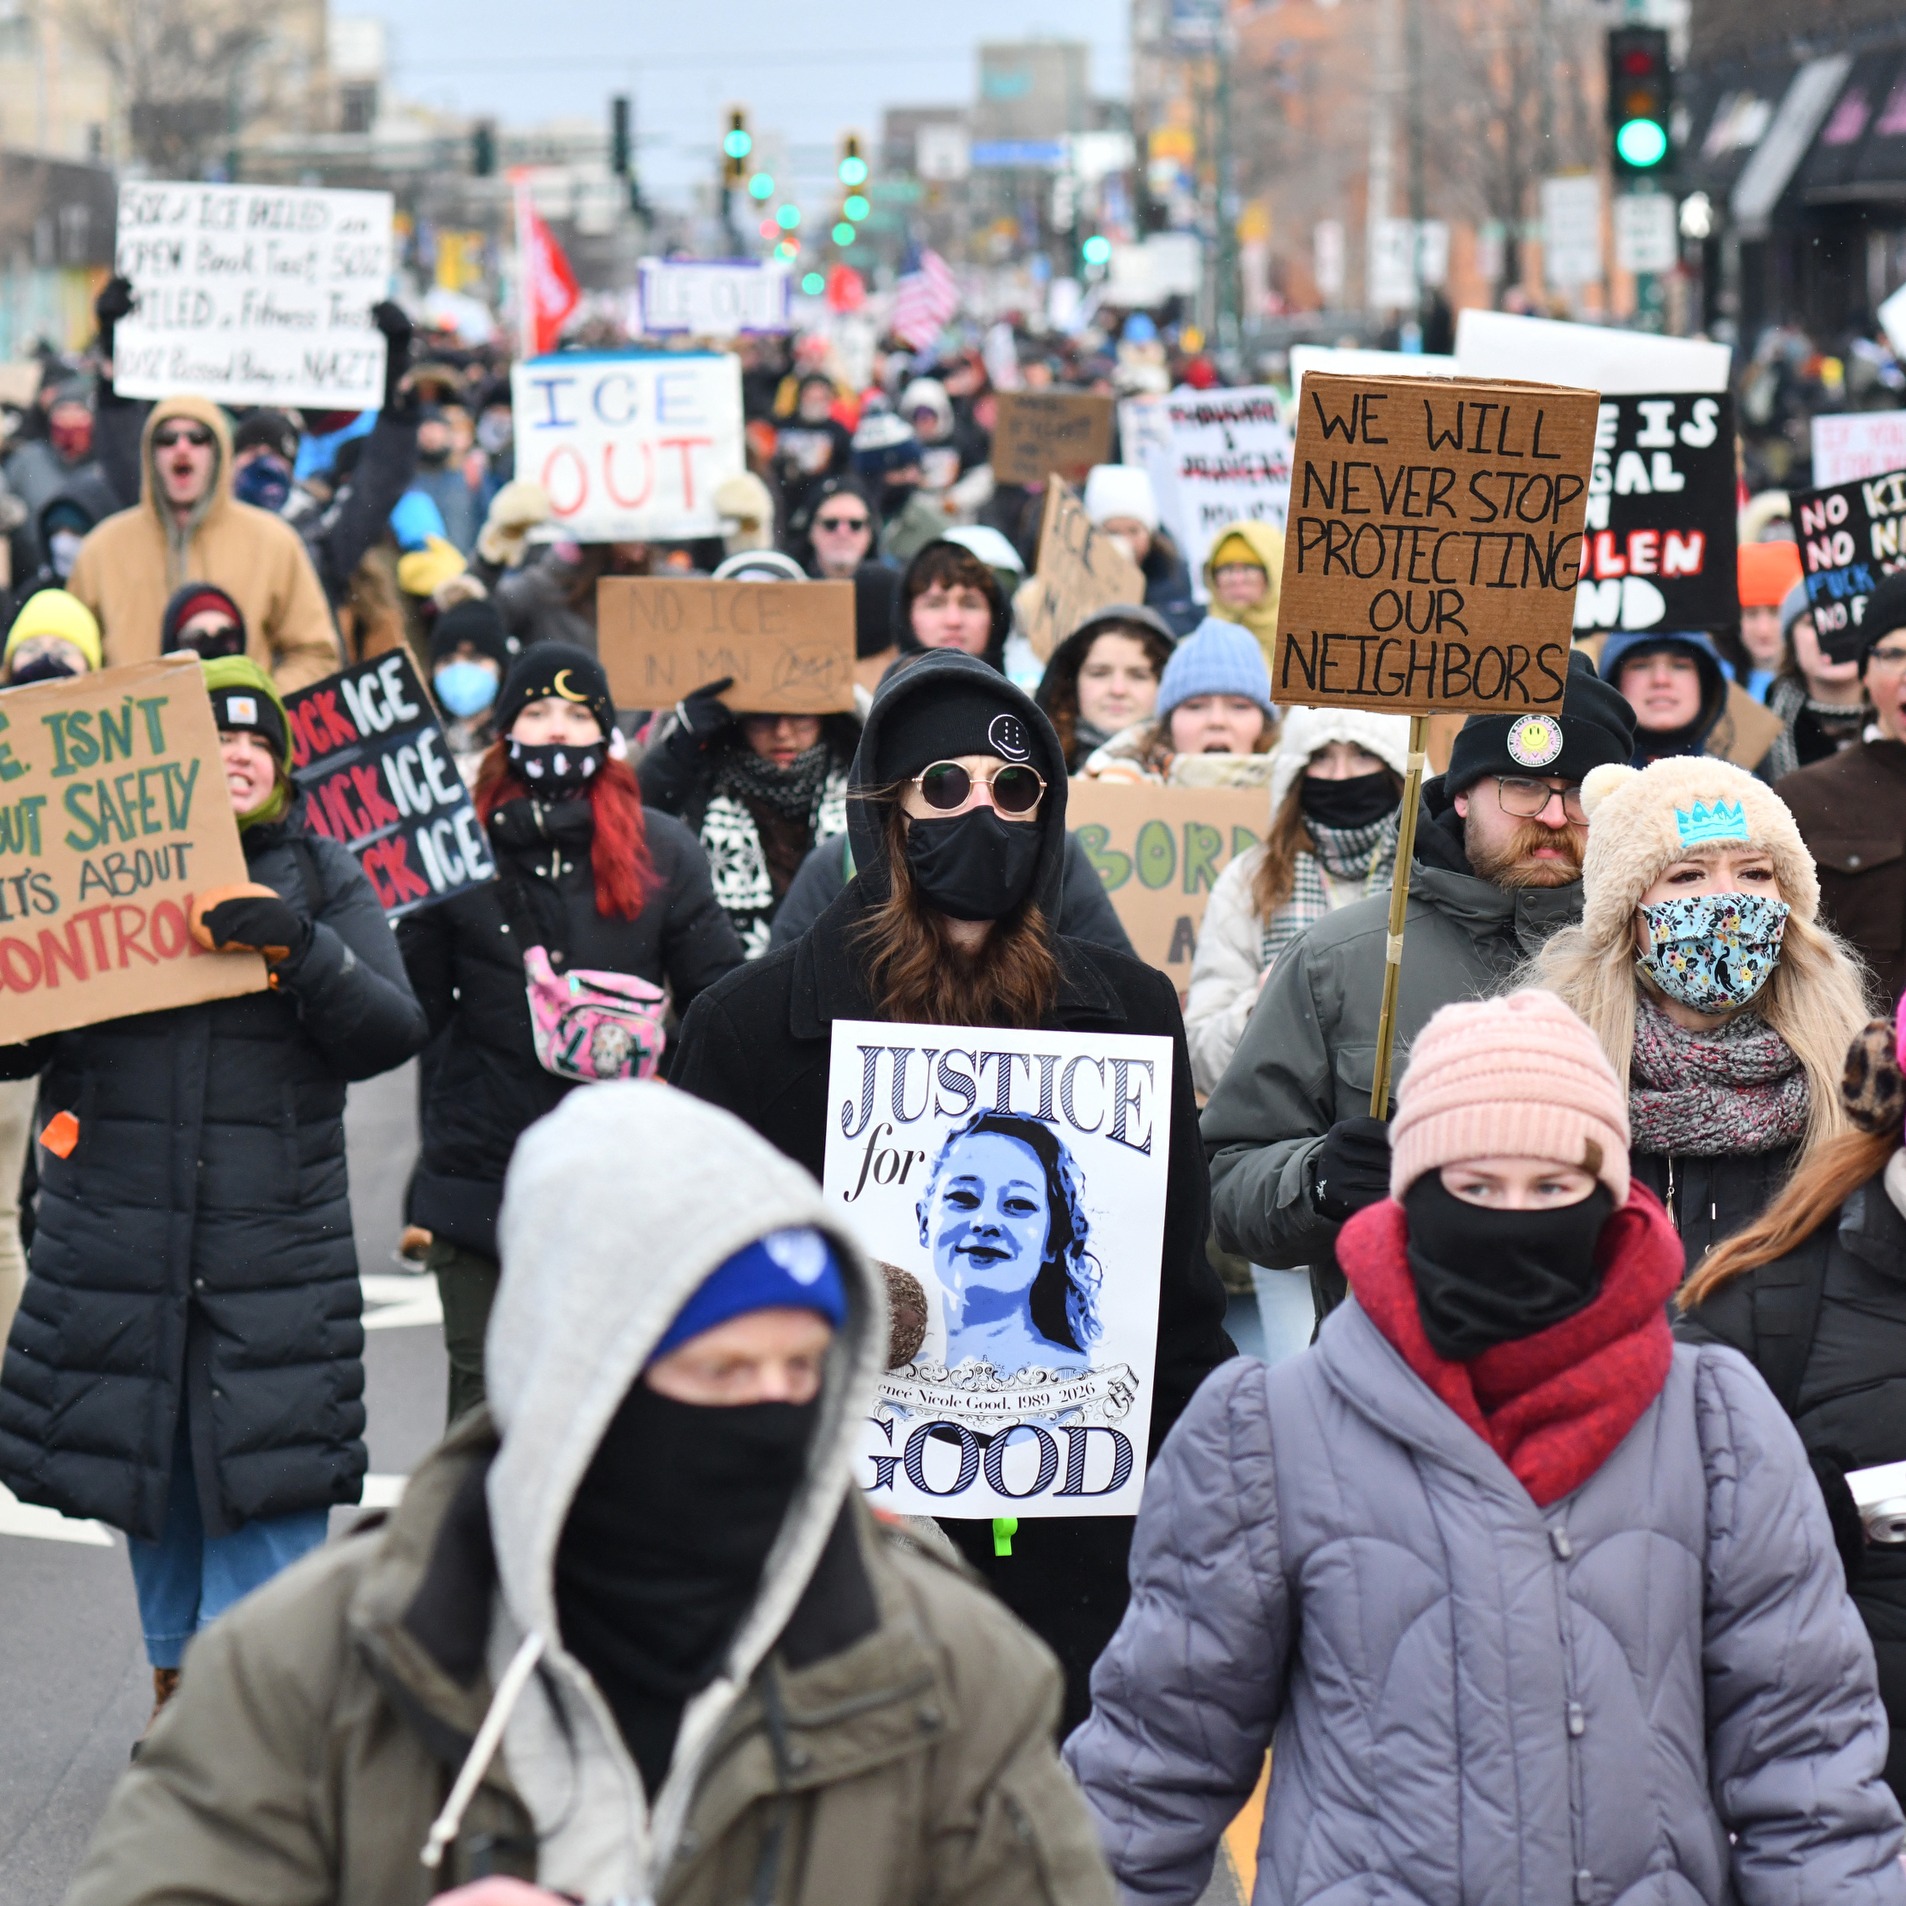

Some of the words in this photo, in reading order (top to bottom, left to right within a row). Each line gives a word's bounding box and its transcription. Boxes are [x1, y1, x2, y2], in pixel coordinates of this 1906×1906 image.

[530, 370, 708, 429] ICE
[1312, 392, 1388, 444] WE
[1423, 399, 1561, 460] WILL
[1636, 398, 1719, 448] IS
[541, 437, 714, 518] OUT
[1302, 460, 1457, 518] NEVER
[1468, 469, 1585, 524] STOP
[1801, 494, 1849, 536] NO
[1806, 530, 1855, 572] NO
[1870, 514, 1906, 559] N
[1297, 516, 1586, 591] PROTECTING
[1806, 562, 1876, 600] FUCK
[628, 586, 684, 633] NO
[701, 587, 787, 634] ICE
[1369, 588, 1468, 636] OUR
[1814, 601, 1848, 635] NO
[340, 656, 420, 737] ICE
[1282, 631, 1564, 704] NEIGHBORS
[41, 696, 168, 777] ISN'T
[0, 795, 47, 857] UT
[64, 758, 200, 852] SAFETY
[304, 765, 400, 843] UCK
[381, 727, 463, 817] ICE
[79, 842, 194, 900] ABOUT
[416, 806, 494, 893] ICE
[842, 1045, 1154, 1156] JUSTICE
[843, 1122, 925, 1203] for
[916, 1389, 962, 1408] Nicole
[1018, 1393, 1050, 1409] 1989
[1059, 1382, 1095, 1403] 2026
